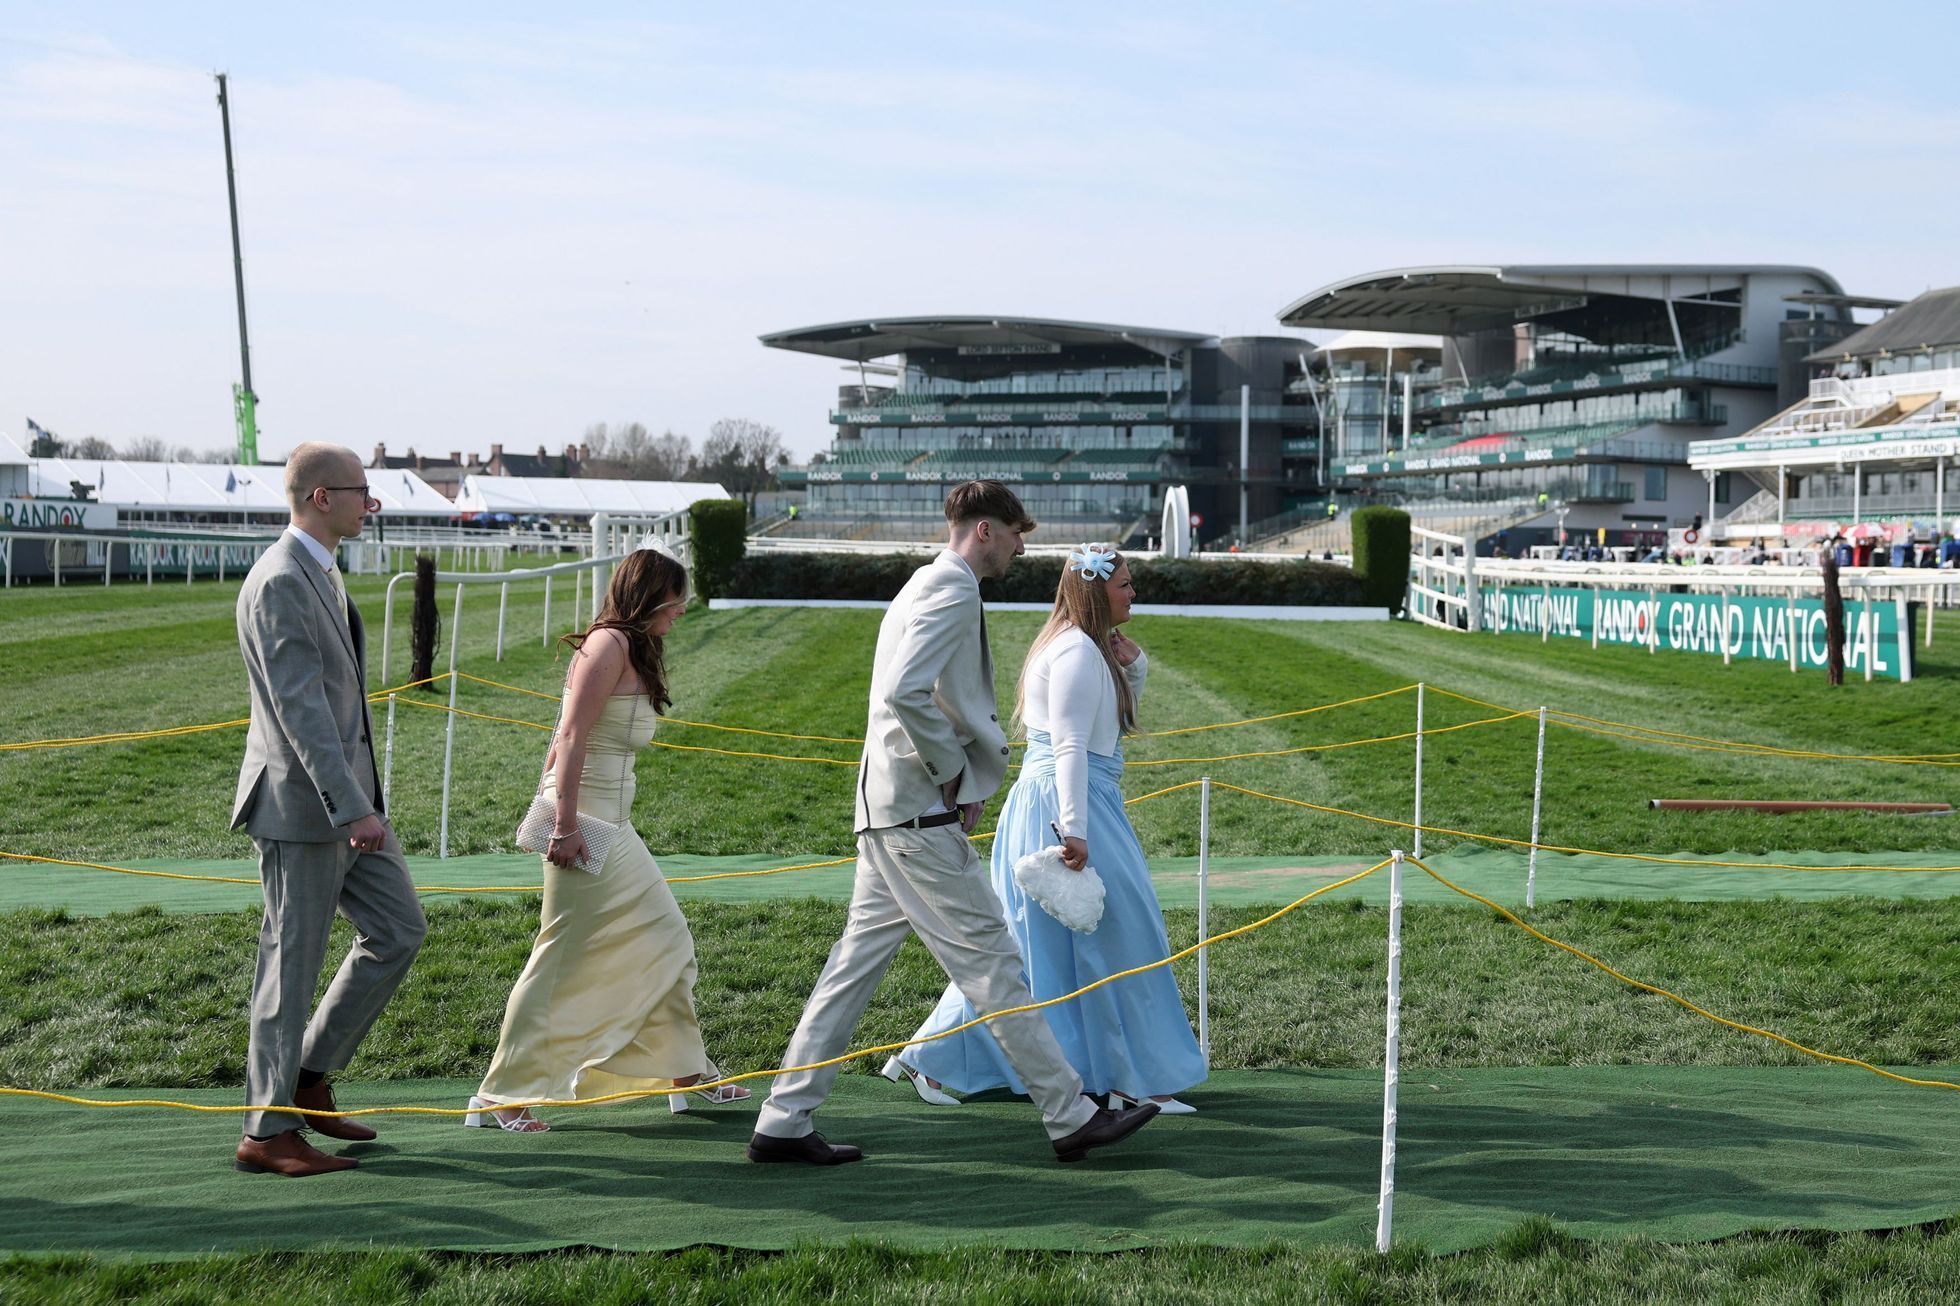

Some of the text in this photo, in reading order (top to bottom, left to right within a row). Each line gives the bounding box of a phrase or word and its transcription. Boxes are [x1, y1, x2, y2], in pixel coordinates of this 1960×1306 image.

[847, 414, 881, 423] RANDOX
[911, 414, 946, 423] RANDOX
[976, 413, 1012, 422] RANDOX
[1043, 412, 1080, 421] RANDOX
[1111, 412, 1149, 421] RANDOX
[1911, 444, 1948, 454] STAND
[807, 472, 842, 481] RANDOX
[906, 472, 1024, 481] RANDOX GRAND NATIONAL
[1090, 471, 1128, 481] RANDOX
[4, 502, 87, 529] RANDOX
[1669, 601, 1745, 655] GRAND
